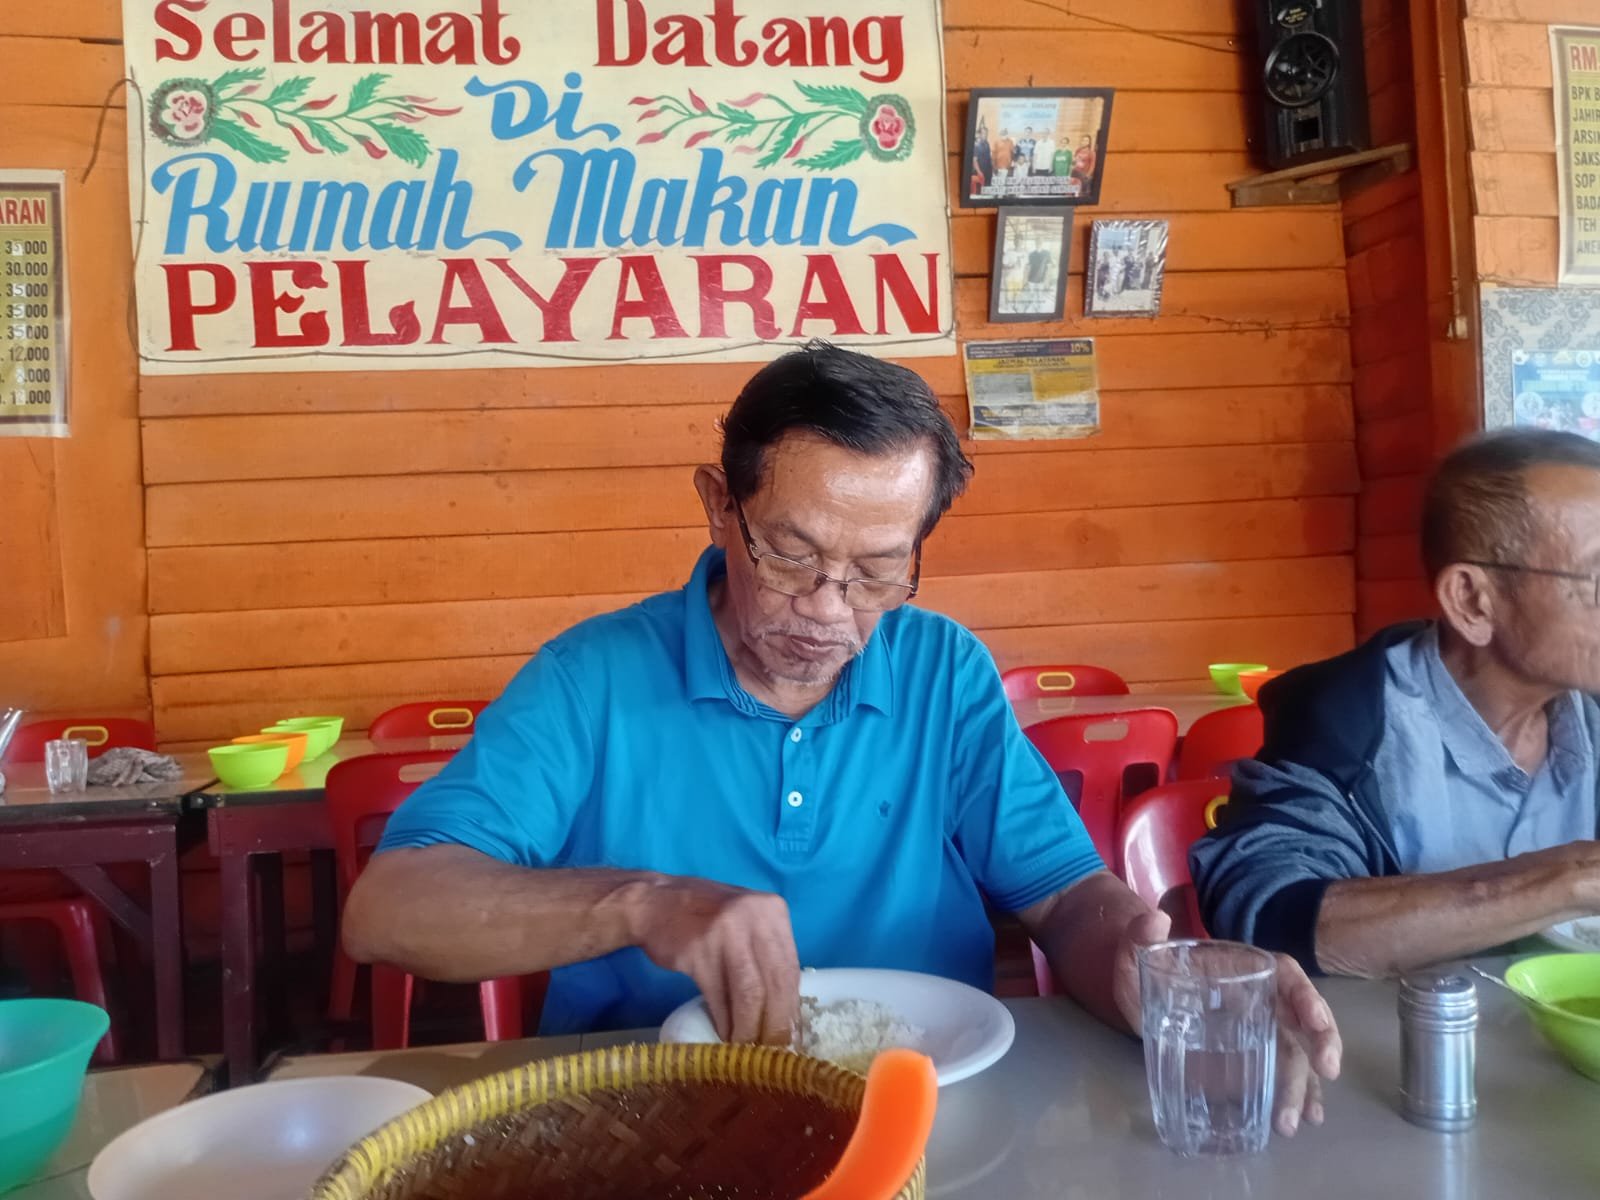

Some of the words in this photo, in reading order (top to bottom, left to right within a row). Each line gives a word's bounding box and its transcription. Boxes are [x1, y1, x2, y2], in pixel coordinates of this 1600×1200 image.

[154, 0, 521, 66] Selamat
[593, 0, 905, 83] Datang
[464, 72, 621, 142] Di
[1571, 85, 1591, 101] BPK
[151, 147, 522, 255] Rumah
[513, 147, 918, 249] Makan
[1575, 173, 1596, 189] SOP
[1577, 217, 1597, 232] TEH
[6, 261, 48, 276] 30.000
[160, 252, 940, 351] PELAYARAN
